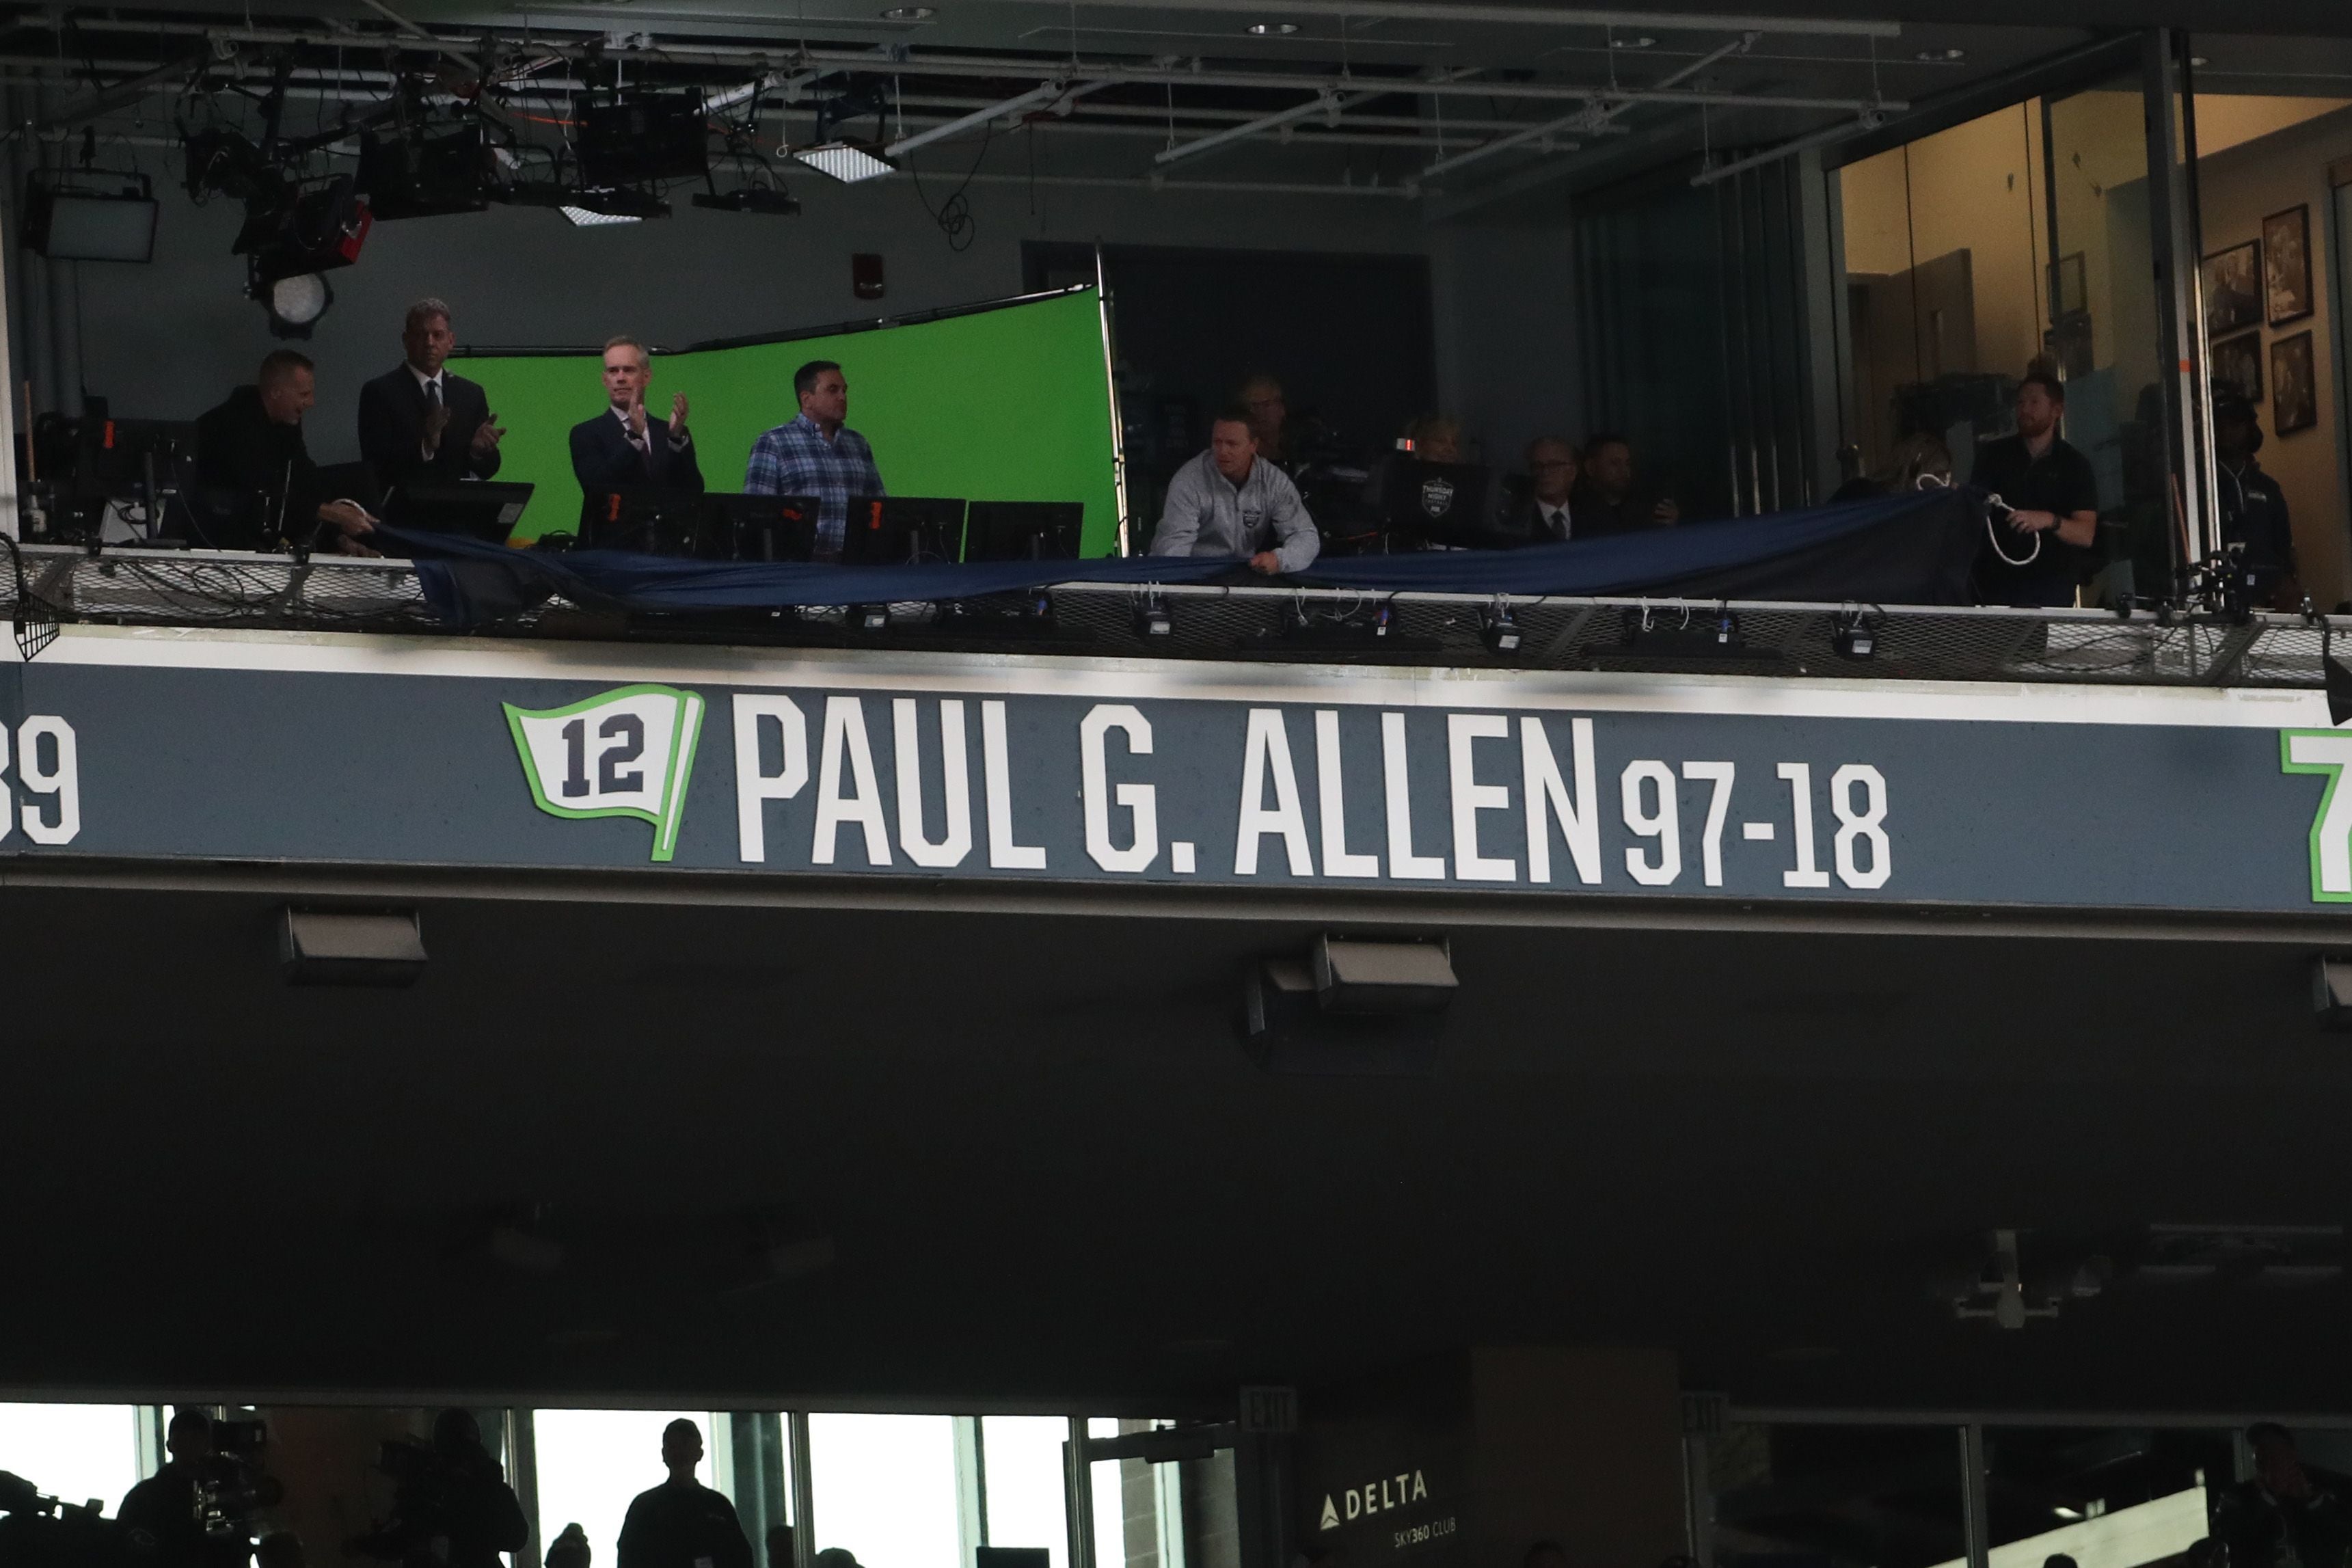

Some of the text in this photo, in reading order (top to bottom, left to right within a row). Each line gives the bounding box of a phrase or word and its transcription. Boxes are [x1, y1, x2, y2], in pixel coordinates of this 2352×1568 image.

[0, 714, 81, 845] 9
[562, 713, 645, 798] 12
[733, 693, 1892, 889] PAUL G. ALLEN 97-18
[2280, 729, 2352, 903] 7
[1683, 1396, 1722, 1433] EXIT
[1344, 1469, 1428, 1521] DELTA
[1394, 1516, 1457, 1547] SKY360 CLUB
